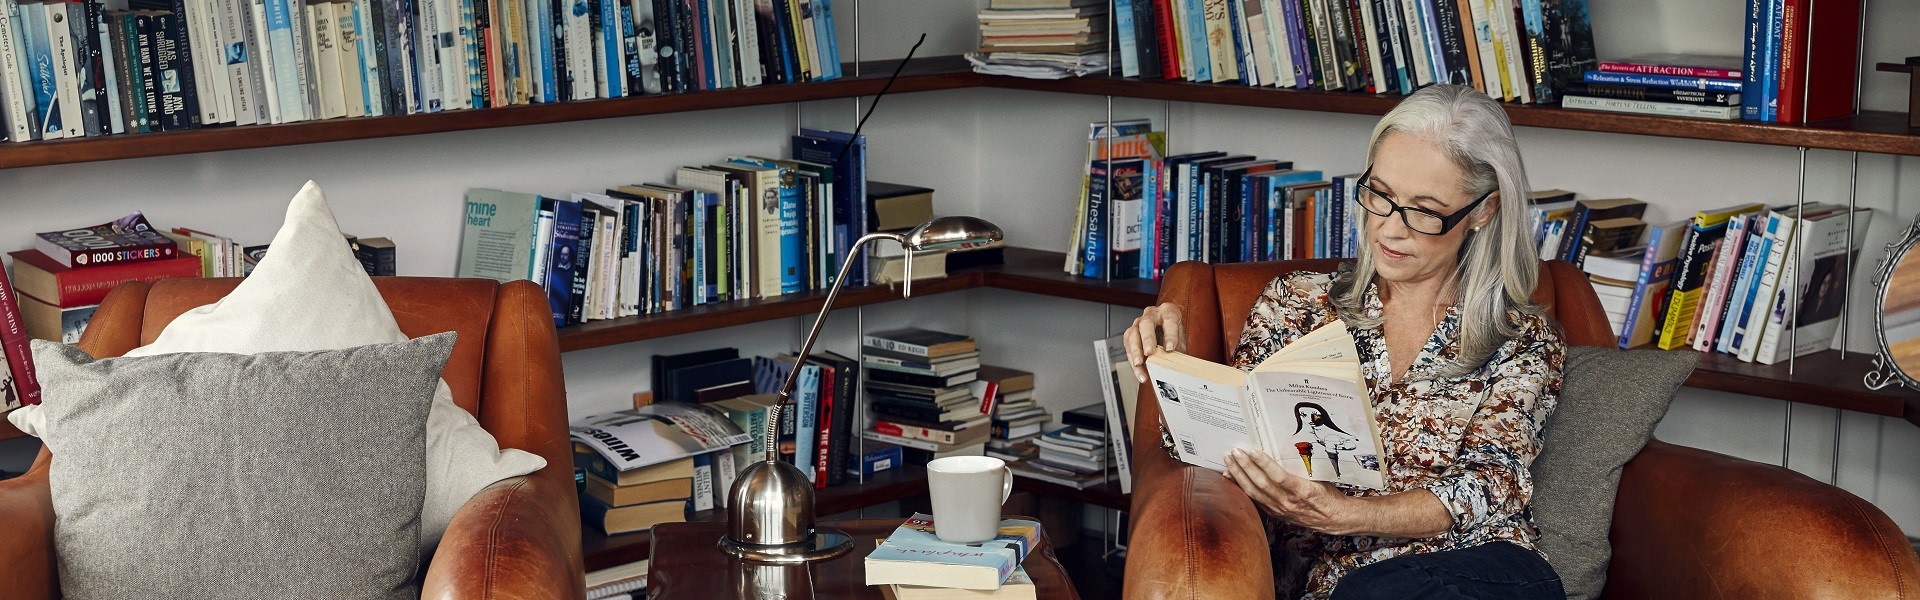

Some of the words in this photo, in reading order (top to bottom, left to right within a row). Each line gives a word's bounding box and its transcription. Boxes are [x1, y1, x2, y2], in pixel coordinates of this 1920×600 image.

[175, 1, 185, 23] AROL
[1214, 0, 1225, 20] Y'S
[1304, 0, 1314, 39] ATHOLOGY
[1773, 4, 1782, 39] AFLOAT
[138, 34, 147, 45] AYN
[156, 31, 168, 69] SHRUGGED
[166, 39, 176, 60] ATLAS
[60, 48, 68, 76] Apologist
[140, 47, 150, 63] RAND
[1321, 40, 1331, 64] Health
[1531, 38, 1542, 84] NIFFENEGGER
[1537, 46, 1545, 72] AUDREY
[143, 67, 151, 76] WE
[1593, 75, 1619, 83] Relaxation
[1642, 78, 1668, 86] Reduction
[1636, 66, 1694, 75] ATTRACTION
[145, 78, 153, 90] THE
[146, 93, 157, 113] LIVING
[163, 94, 174, 114] RAND
[173, 97, 183, 111] AYN
[468, 201, 497, 216] mine
[467, 214, 491, 227] heart
[1088, 192, 1102, 262] Thesaurus
[1687, 231, 1700, 256] Positive
[1746, 240, 1755, 254] HEAL
[93, 252, 114, 263] 1000
[117, 248, 160, 261] STICKERS
[1740, 254, 1751, 280] YOURSELF
[1761, 237, 1785, 288] REIKI
[1677, 254, 1693, 290] Psychology
[0, 282, 8, 301] DOW
[5, 311, 18, 335] WIND
[1663, 298, 1682, 334] DUMMIES
[908, 346, 925, 355] REGIS
[782, 404, 790, 435] PATTERSON
[802, 392, 812, 428] PATTERSON
[750, 413, 758, 454] PATTERSON
[821, 429, 829, 445] THE
[819, 449, 827, 472] RACE
[696, 469, 704, 500] WITNESS
[703, 471, 711, 494] SILENT
